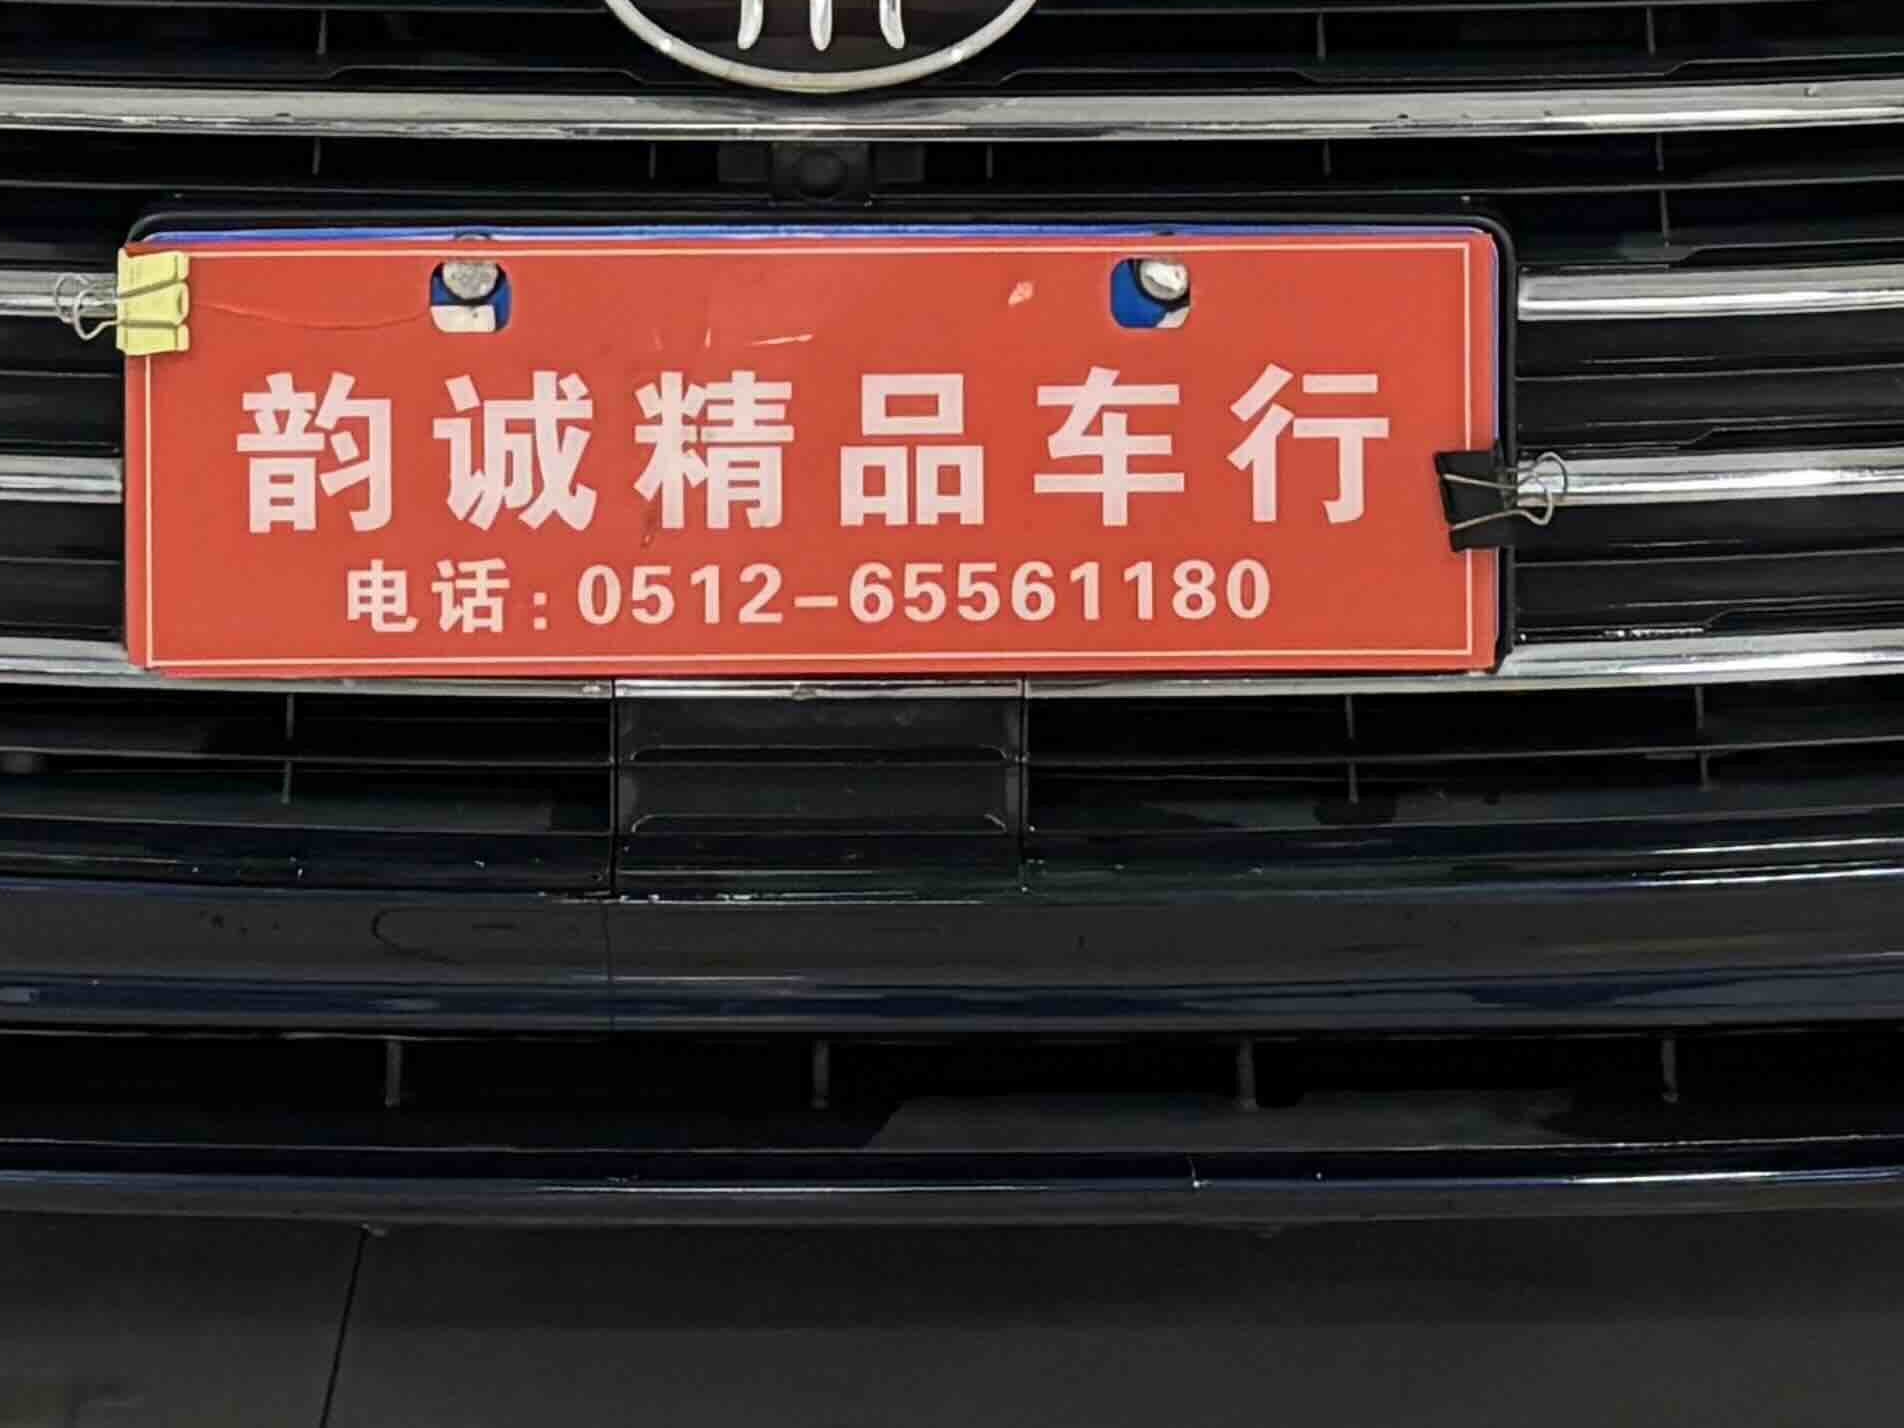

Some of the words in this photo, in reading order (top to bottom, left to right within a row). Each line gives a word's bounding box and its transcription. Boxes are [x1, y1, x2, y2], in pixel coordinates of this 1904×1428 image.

[235, 362, 1392, 533] 韵诚精品车行
